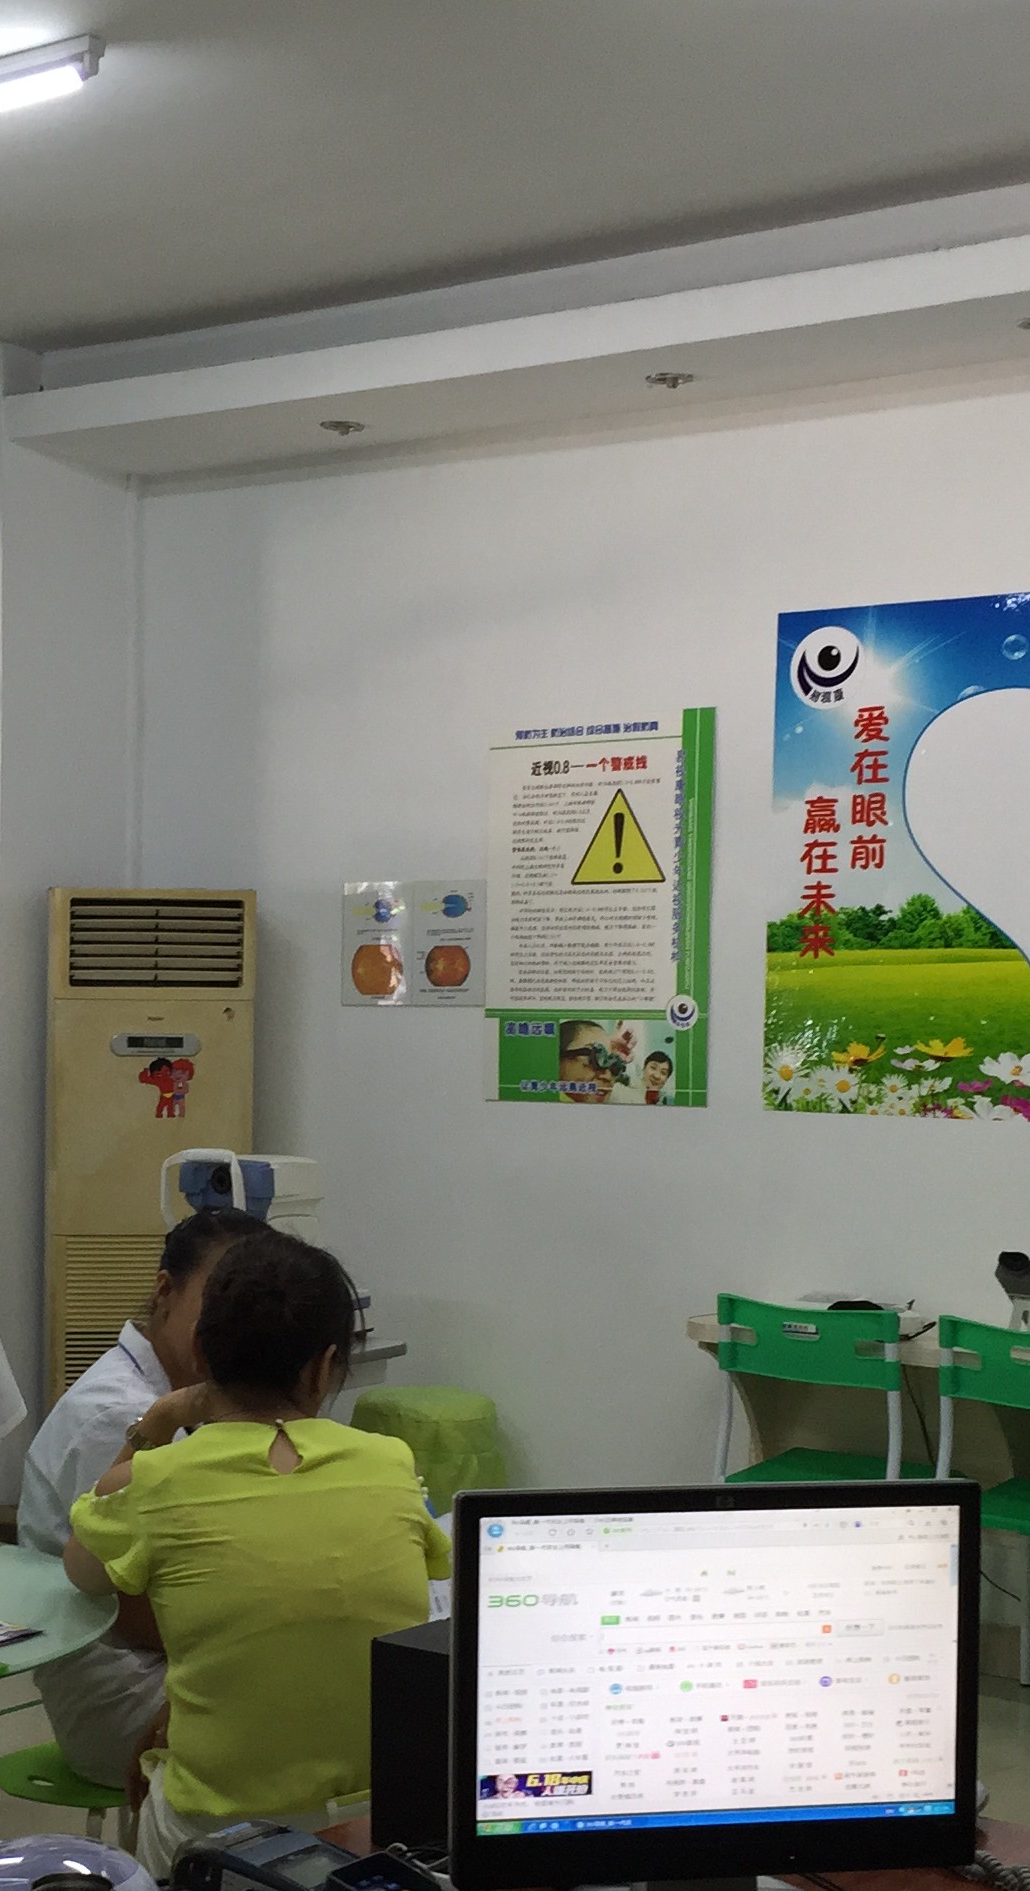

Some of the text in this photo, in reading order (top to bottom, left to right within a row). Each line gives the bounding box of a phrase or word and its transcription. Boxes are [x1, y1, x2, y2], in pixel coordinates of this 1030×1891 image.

[849, 705, 890, 871] 爱在眼前
[799, 796, 841, 960] 赢在未来
